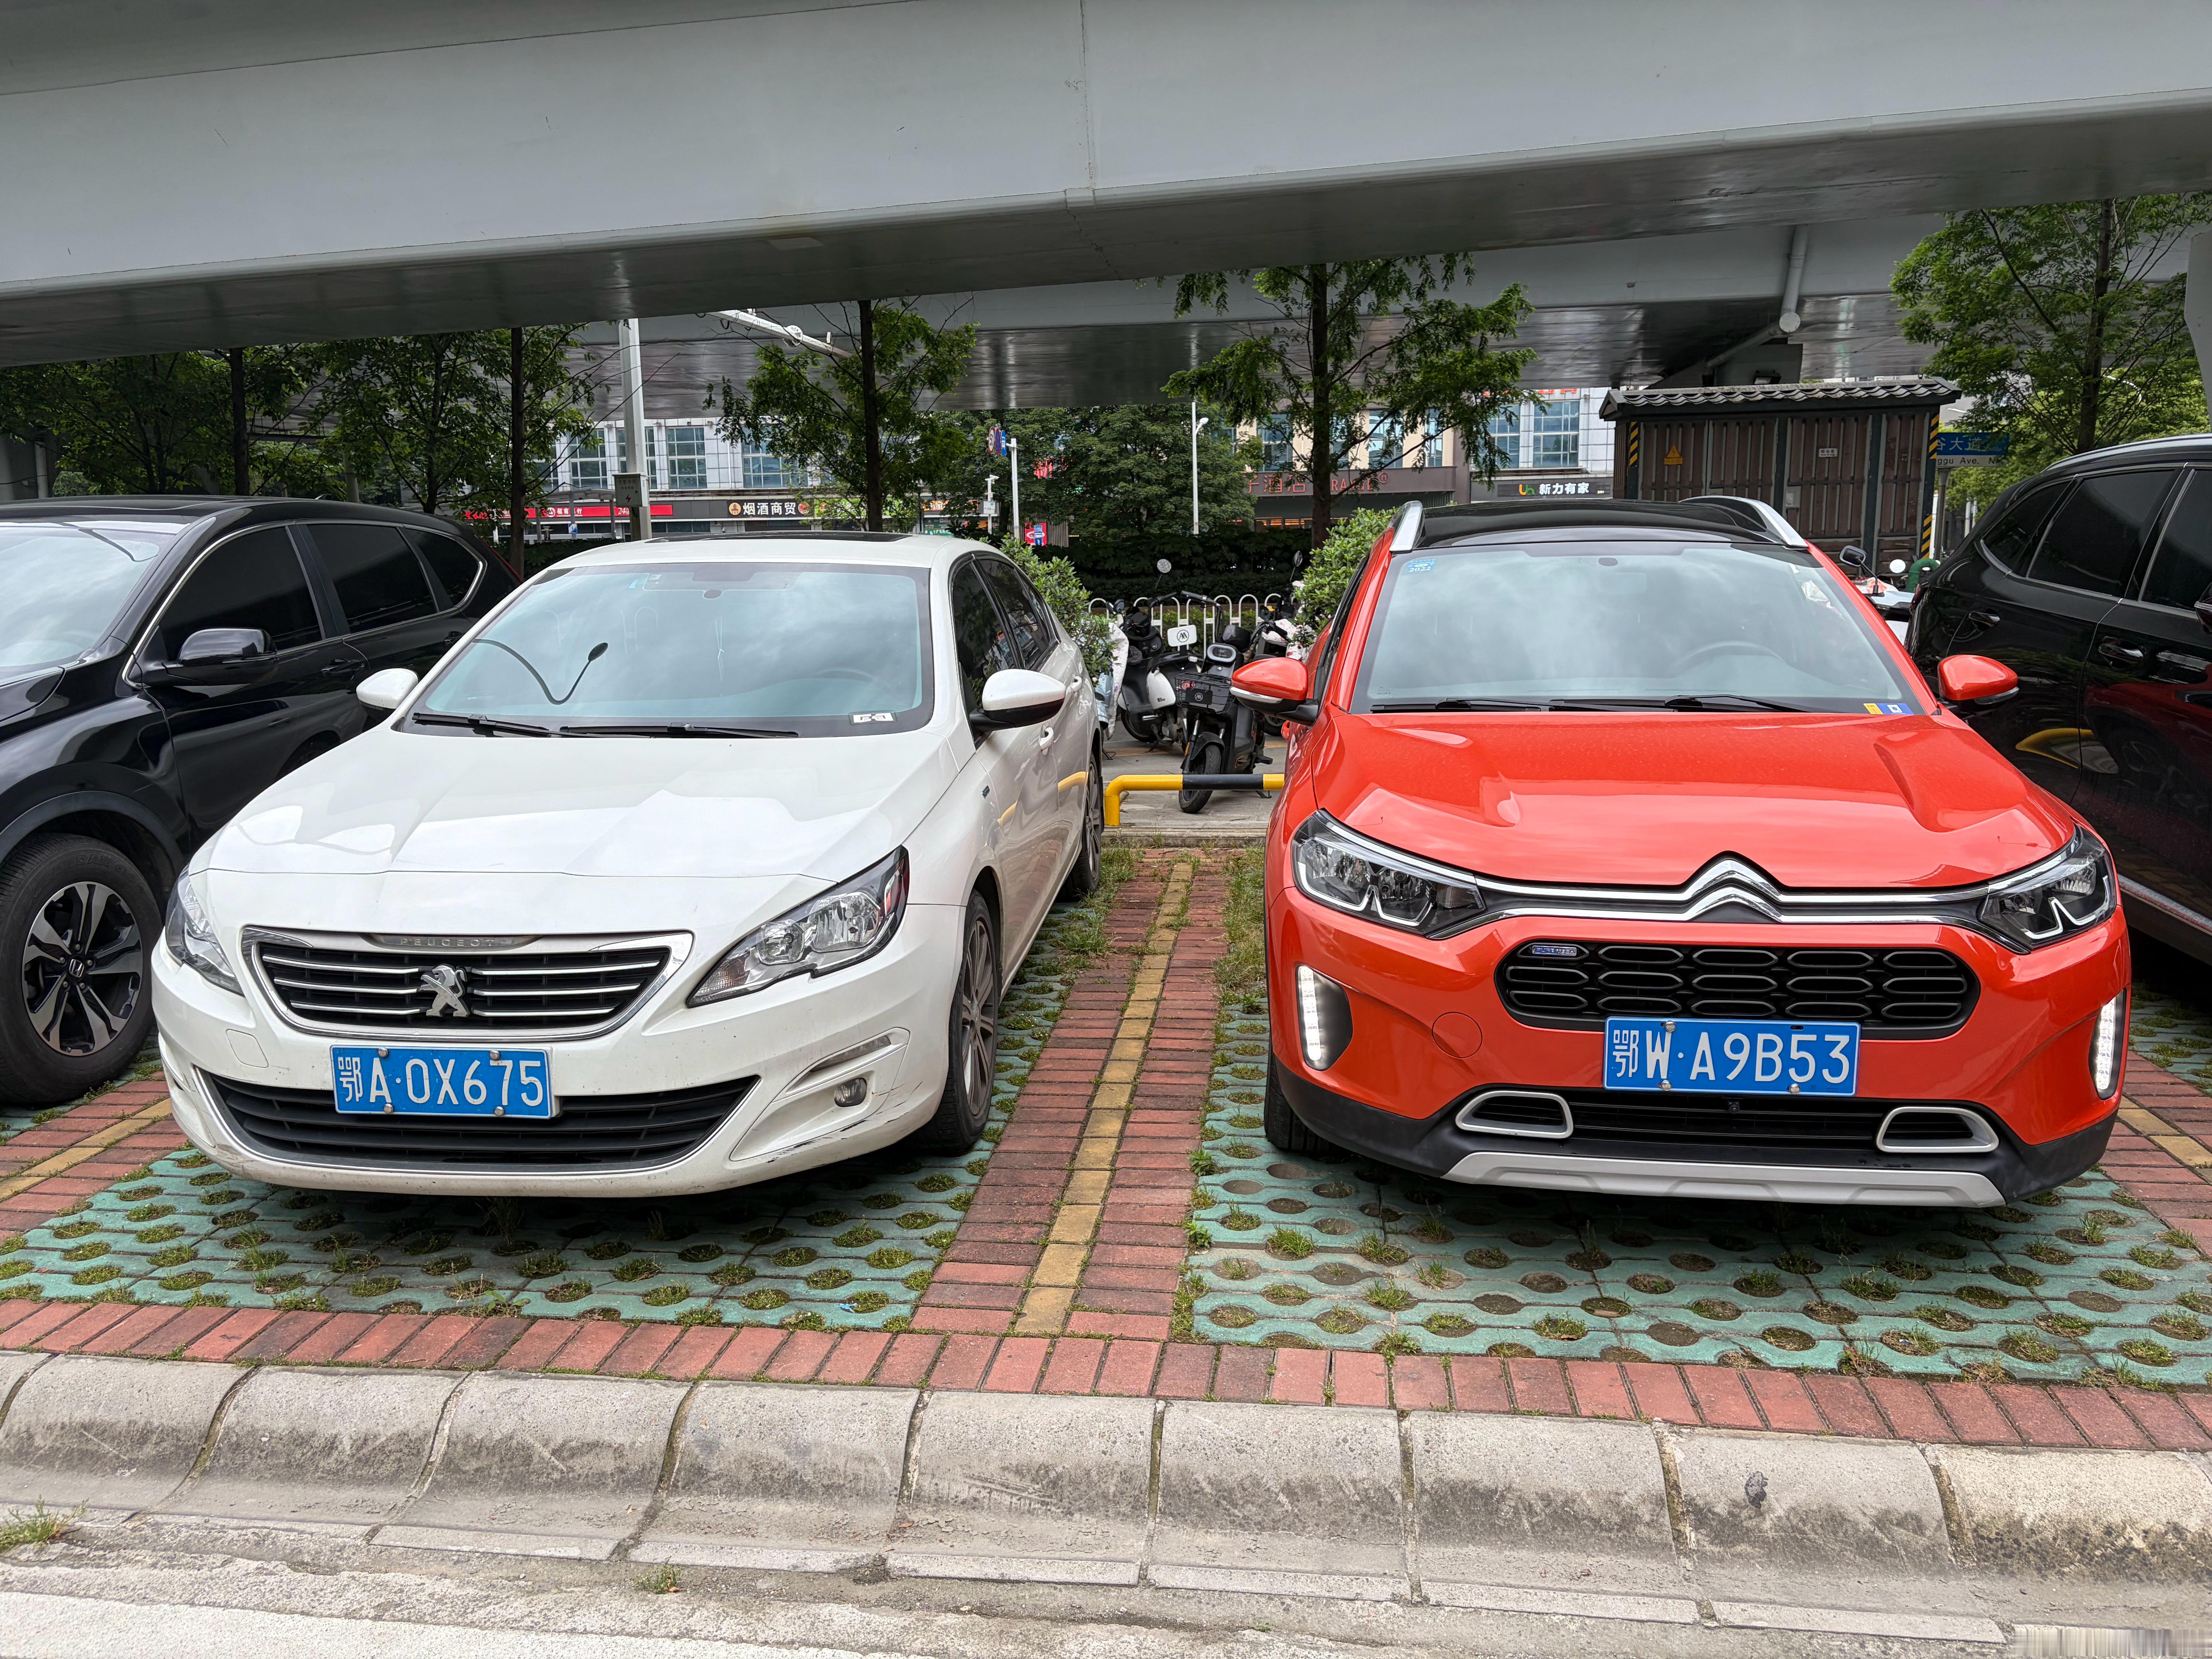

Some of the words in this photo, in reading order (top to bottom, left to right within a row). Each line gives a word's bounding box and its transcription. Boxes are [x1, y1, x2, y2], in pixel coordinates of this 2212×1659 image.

[1539, 482, 1589, 495] 新力有家
[742, 502, 796, 515] 烟酒商贸
[400, 938, 496, 946] PEUGEOT
